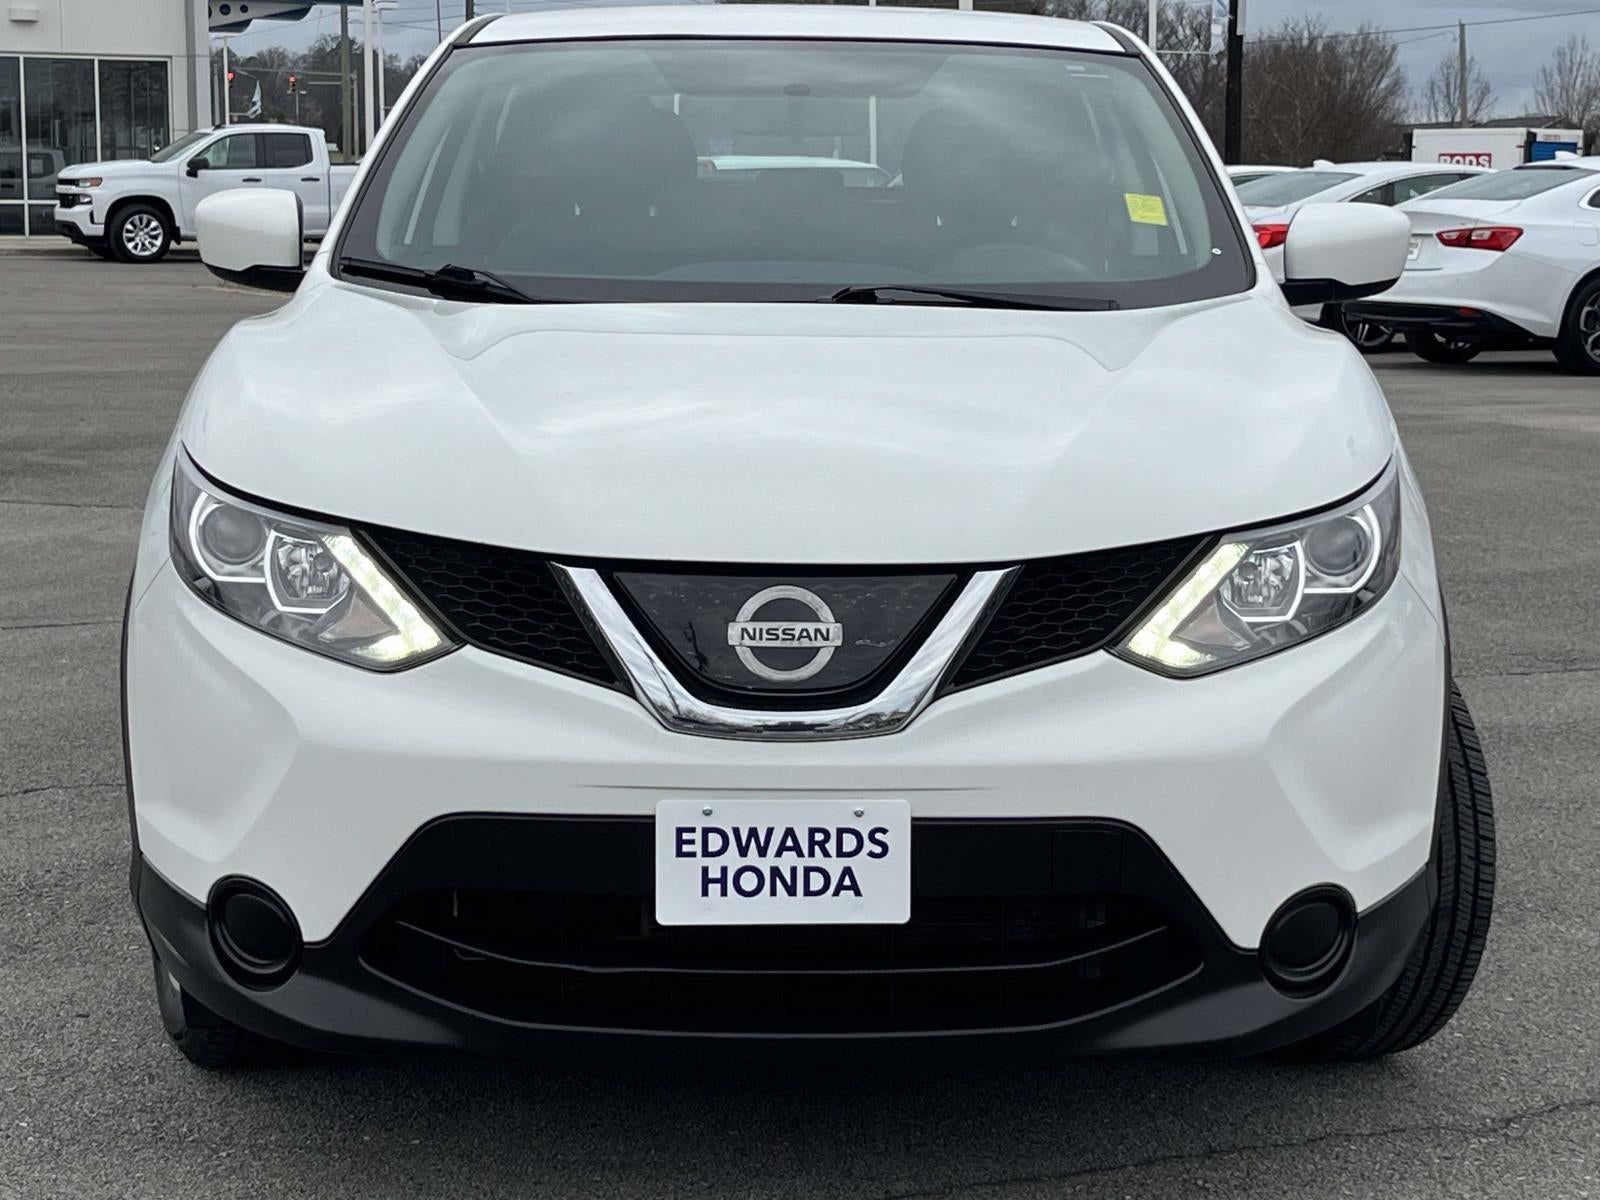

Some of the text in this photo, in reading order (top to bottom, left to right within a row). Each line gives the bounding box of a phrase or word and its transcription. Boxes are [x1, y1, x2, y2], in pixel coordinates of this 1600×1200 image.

[741, 627, 830, 641] NISSAN
[675, 826, 890, 859] EDWARDS
[701, 865, 863, 897] HONDA
